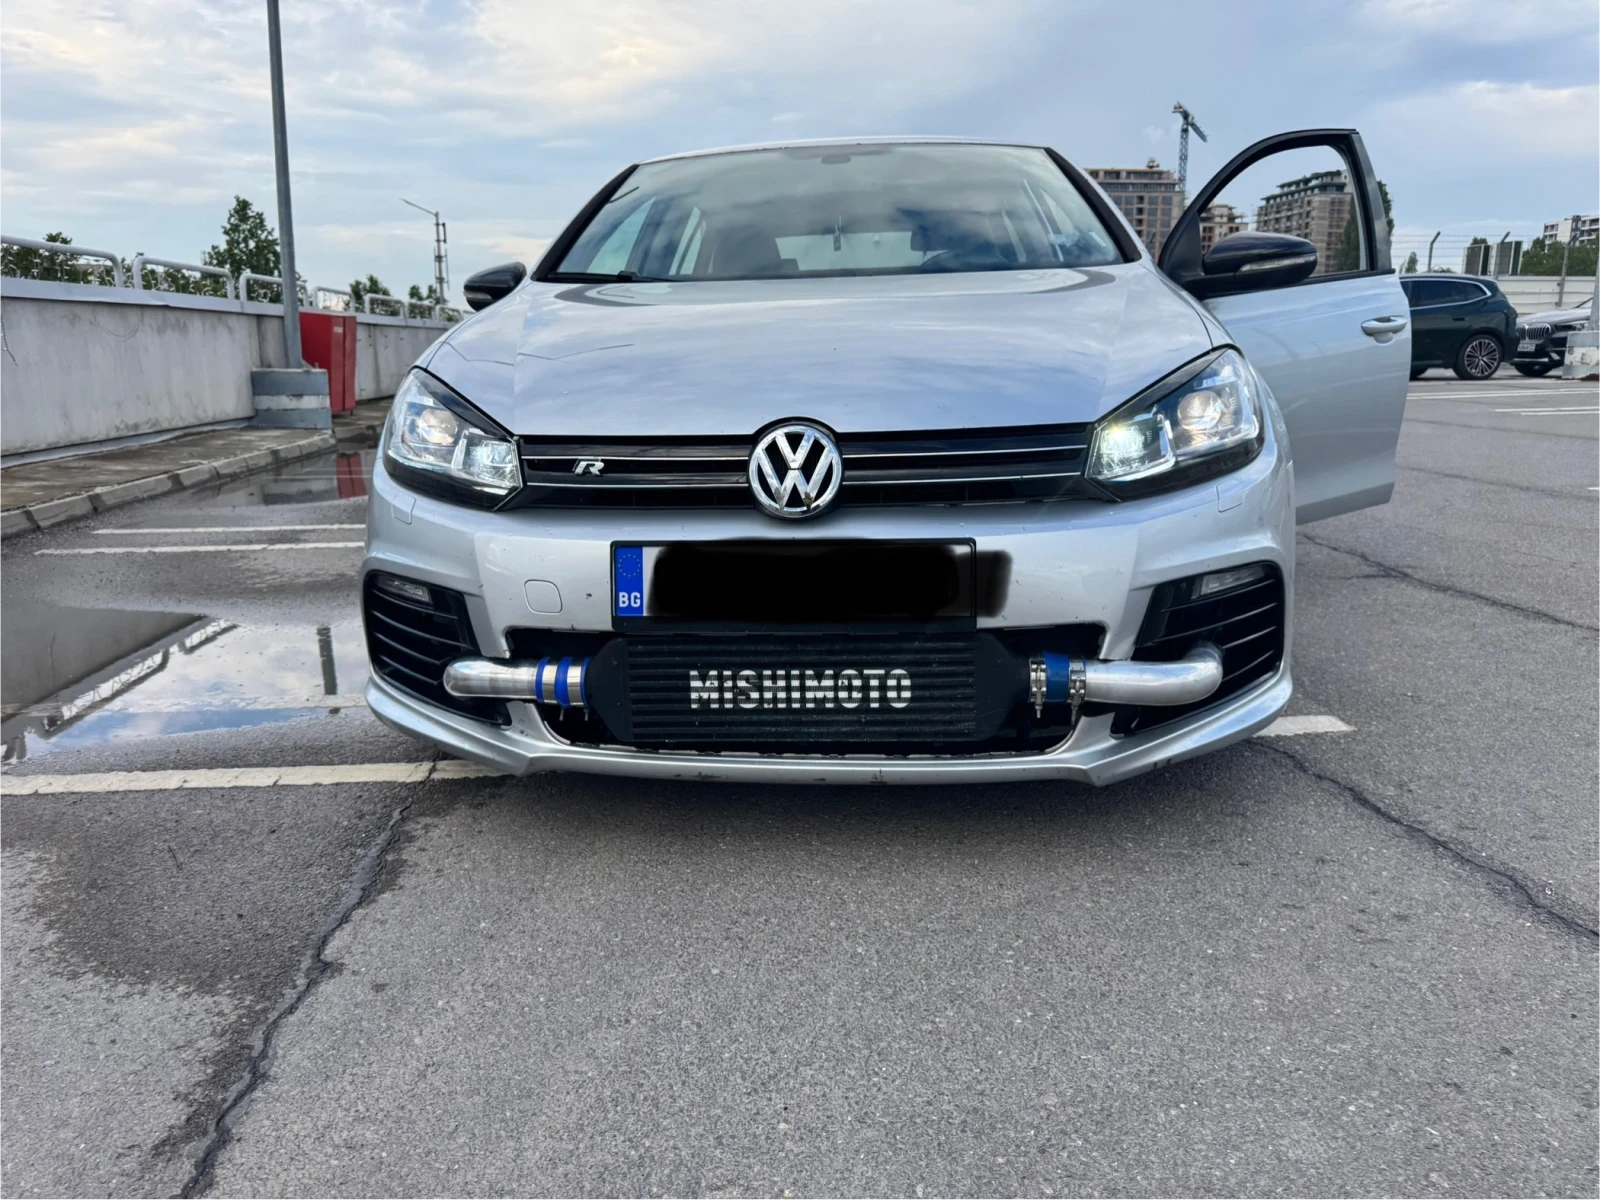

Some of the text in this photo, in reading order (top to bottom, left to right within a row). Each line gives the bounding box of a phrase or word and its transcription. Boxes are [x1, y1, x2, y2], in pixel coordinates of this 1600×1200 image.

[574, 460, 605, 476] R
[752, 427, 840, 512] VW
[618, 591, 641, 608] BG
[689, 668, 912, 709] MISHIMOTO
